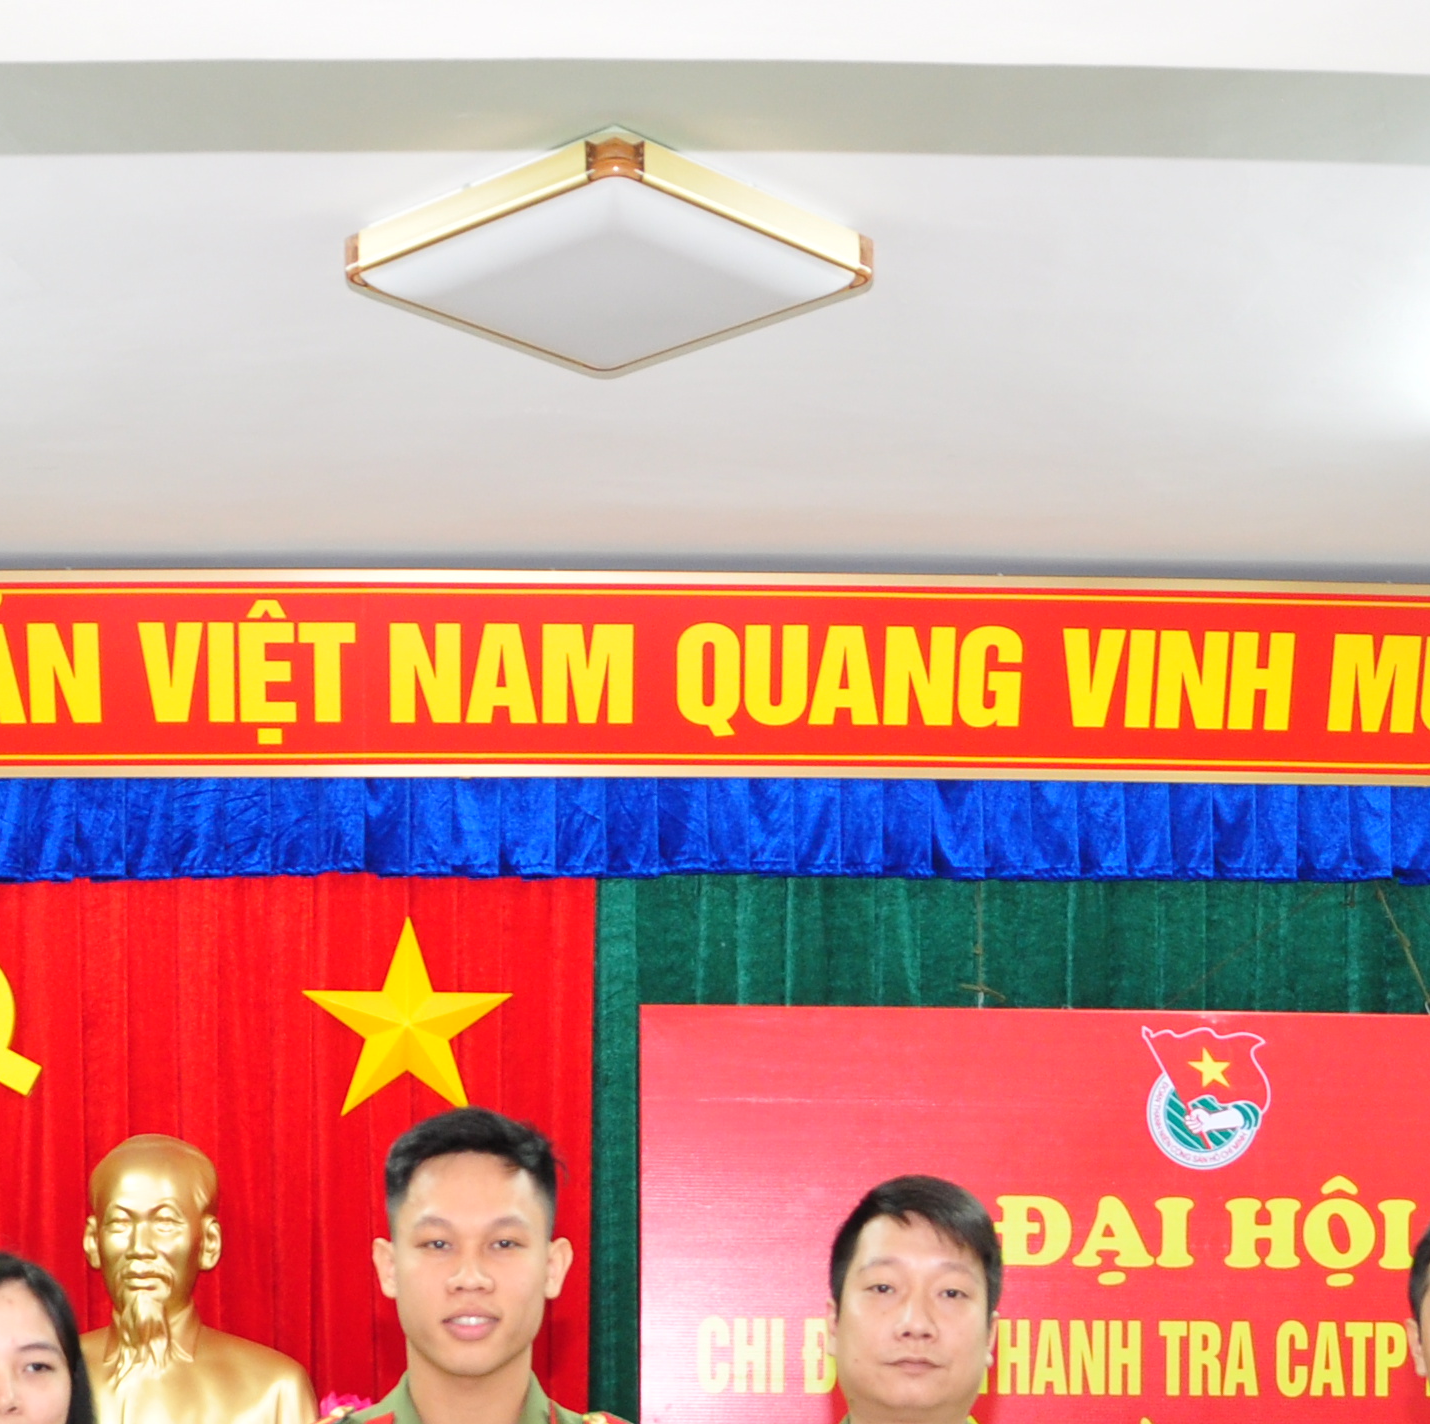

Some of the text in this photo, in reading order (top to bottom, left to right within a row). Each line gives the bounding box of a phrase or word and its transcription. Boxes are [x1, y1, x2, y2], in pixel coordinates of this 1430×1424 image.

[137, 599, 356, 745] VIỆT
[389, 622, 635, 724] NAM
[676, 622, 1023, 737] QUANG
[1063, 628, 1296, 731] VINH
[994, 1175, 1417, 1287] ĐẠI HỘI
[696, 1315, 785, 1395] CHI
[1159, 1321, 1259, 1397] TRA
[1275, 1320, 1408, 1398] CATP
